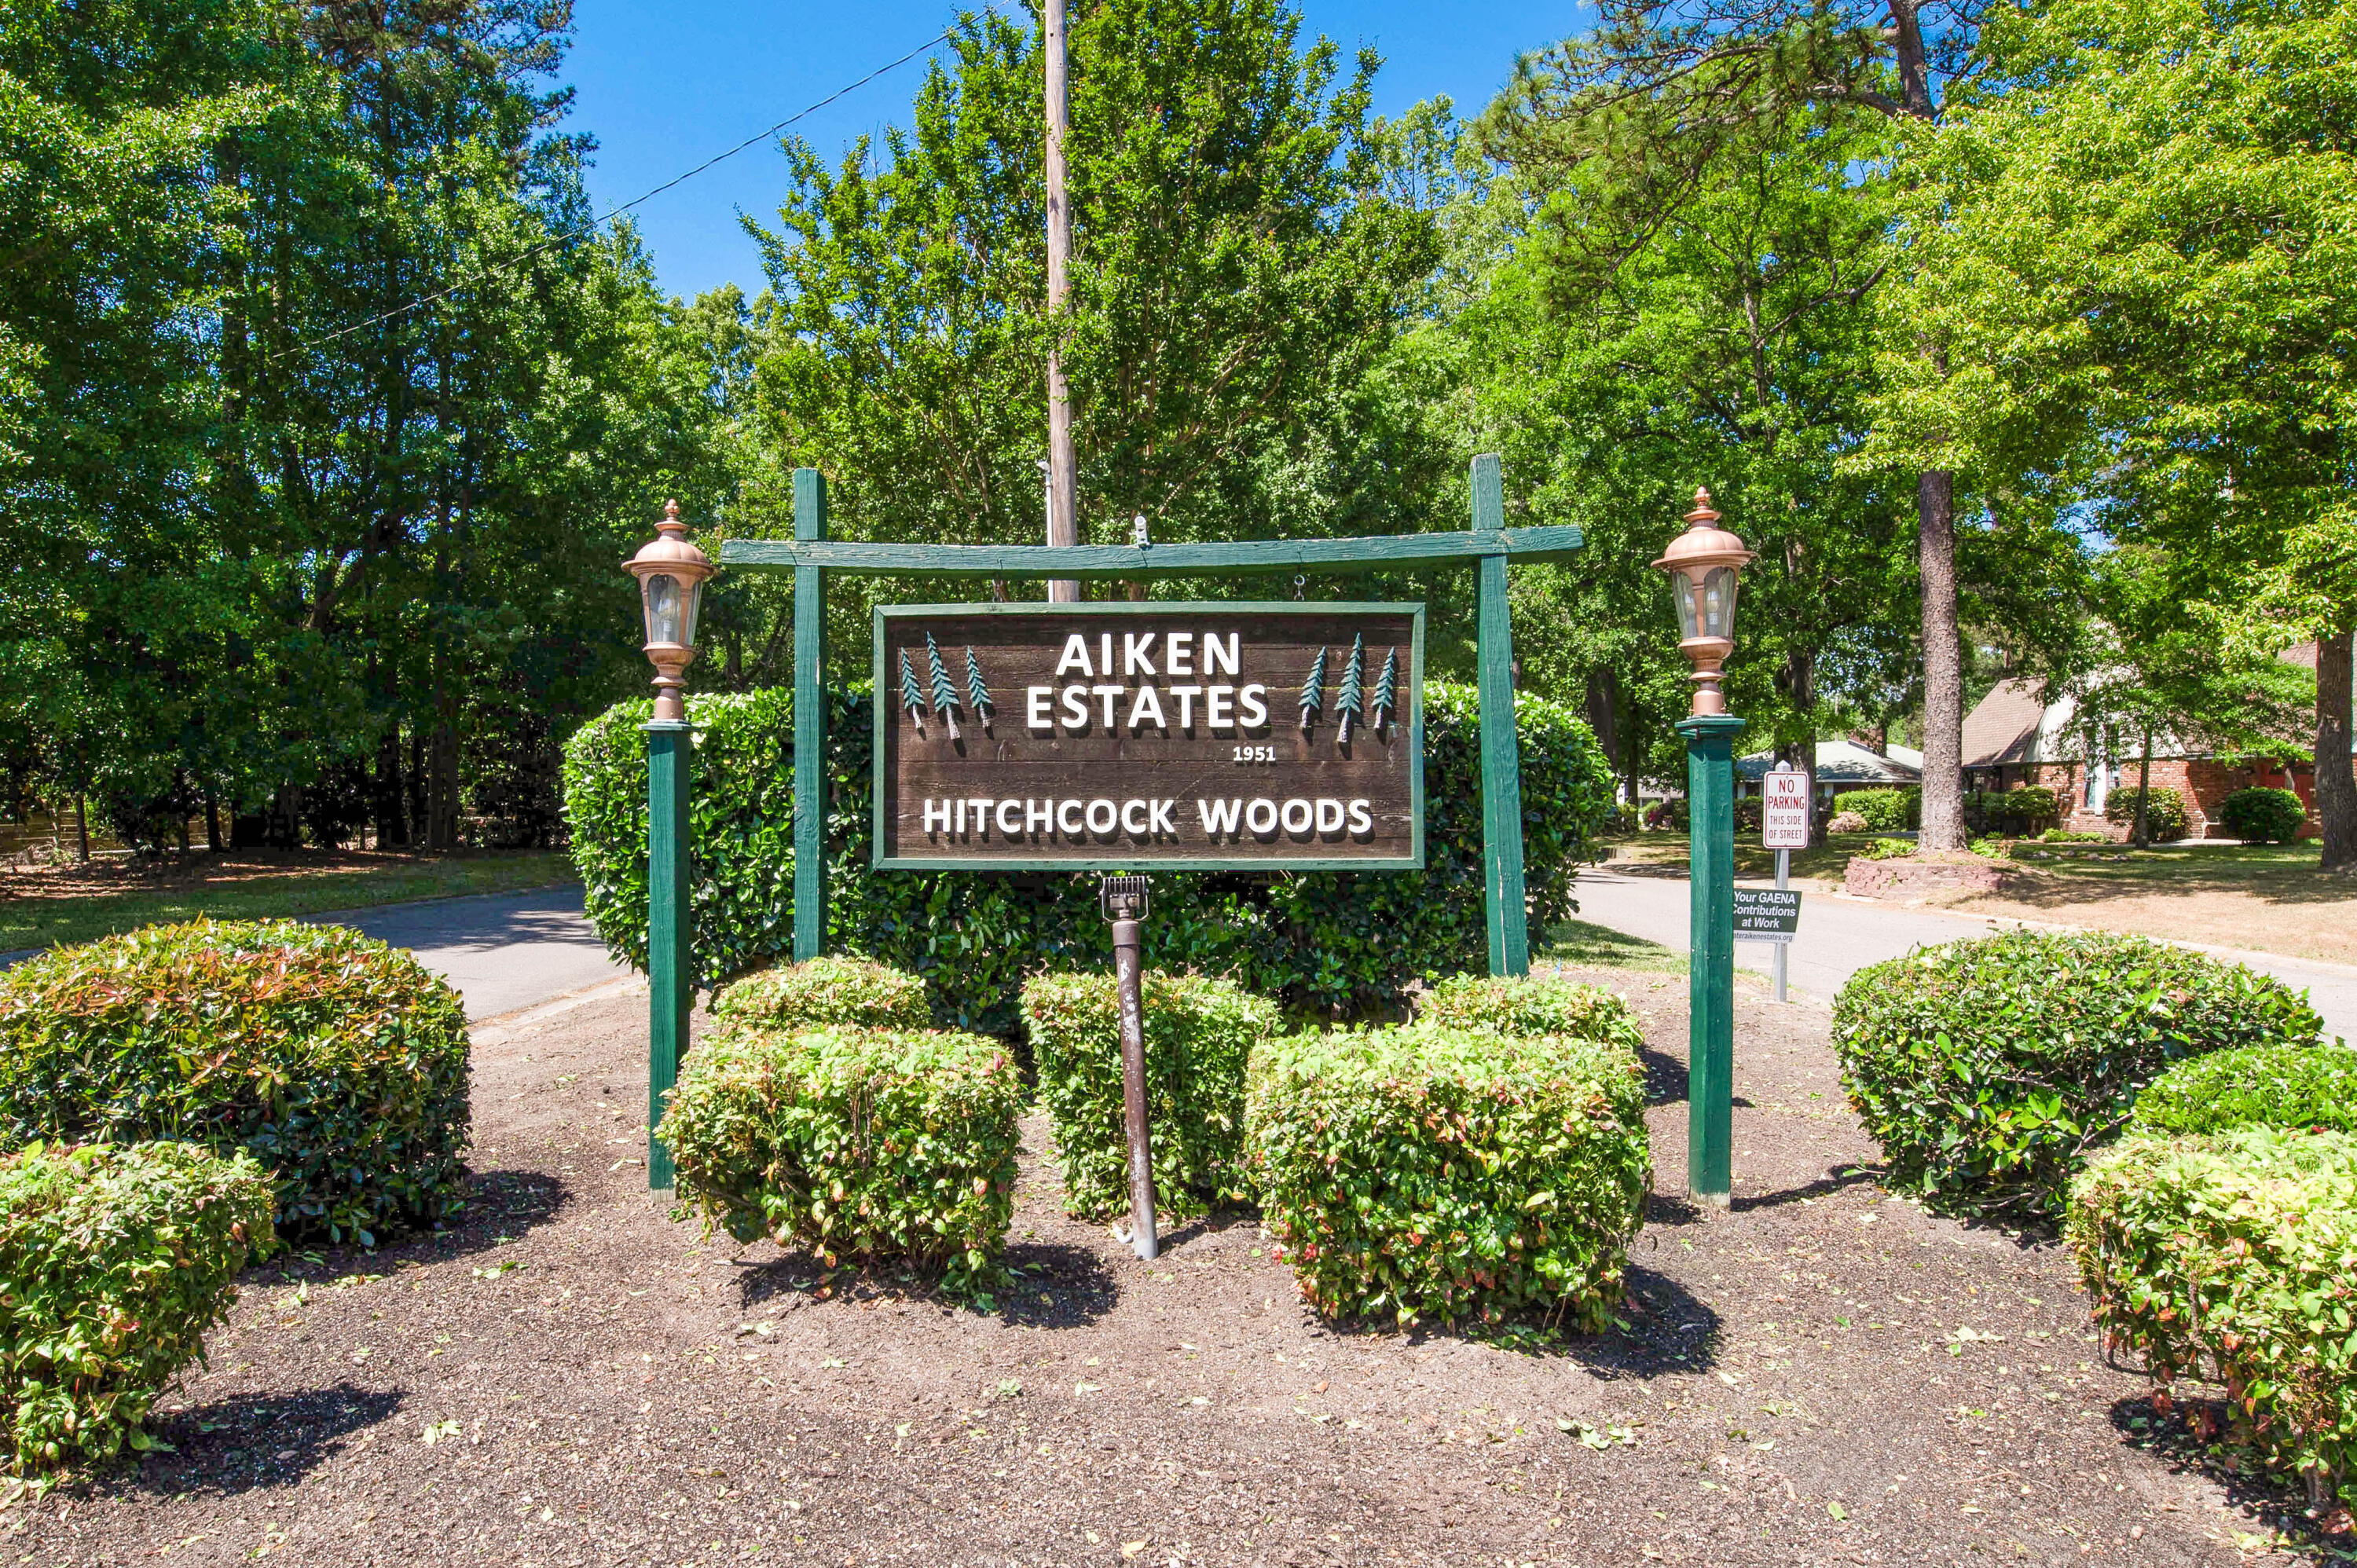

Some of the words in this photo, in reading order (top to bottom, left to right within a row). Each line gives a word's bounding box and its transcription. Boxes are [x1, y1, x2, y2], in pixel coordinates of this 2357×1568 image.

[1054, 632, 1240, 676] AIKEN
[1026, 683, 1268, 729] ESTATES
[1232, 746, 1277, 762] 1951
[1779, 779, 1794, 793] NO
[1768, 796, 1805, 810] PARKING
[924, 797, 1176, 833] HITCHCOCK
[1198, 797, 1373, 833] WOODS
[1769, 815, 1784, 825] THIS
[1787, 815, 1802, 825] SIDE
[1769, 830, 1777, 839] OF
[1780, 830, 1802, 839] STREET
[1734, 891, 1757, 903] Your
[1758, 892, 1796, 904] GAENA
[1741, 918, 1752, 927] at
[1754, 918, 1780, 929] Work
